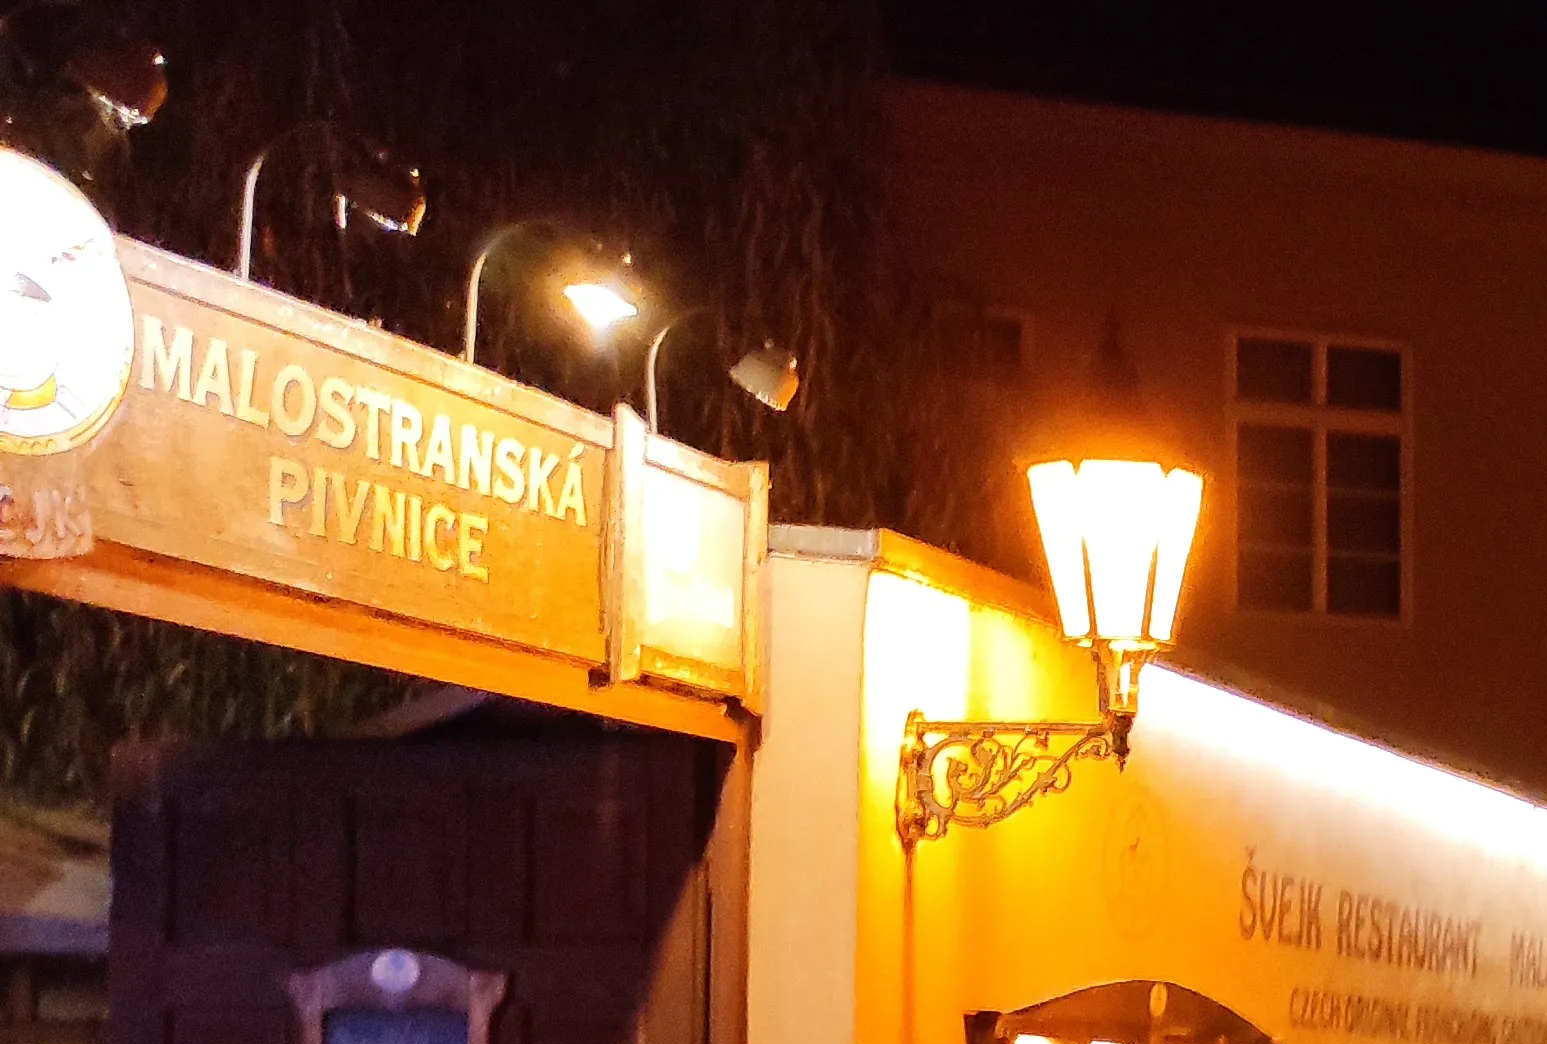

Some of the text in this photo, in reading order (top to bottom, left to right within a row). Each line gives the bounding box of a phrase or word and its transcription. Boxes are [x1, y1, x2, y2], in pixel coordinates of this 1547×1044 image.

[139, 315, 589, 527] MALOSTRANSKÁ
[267, 457, 490, 583] PIVNICE
[1337, 888, 1483, 978] RESTAURANT
